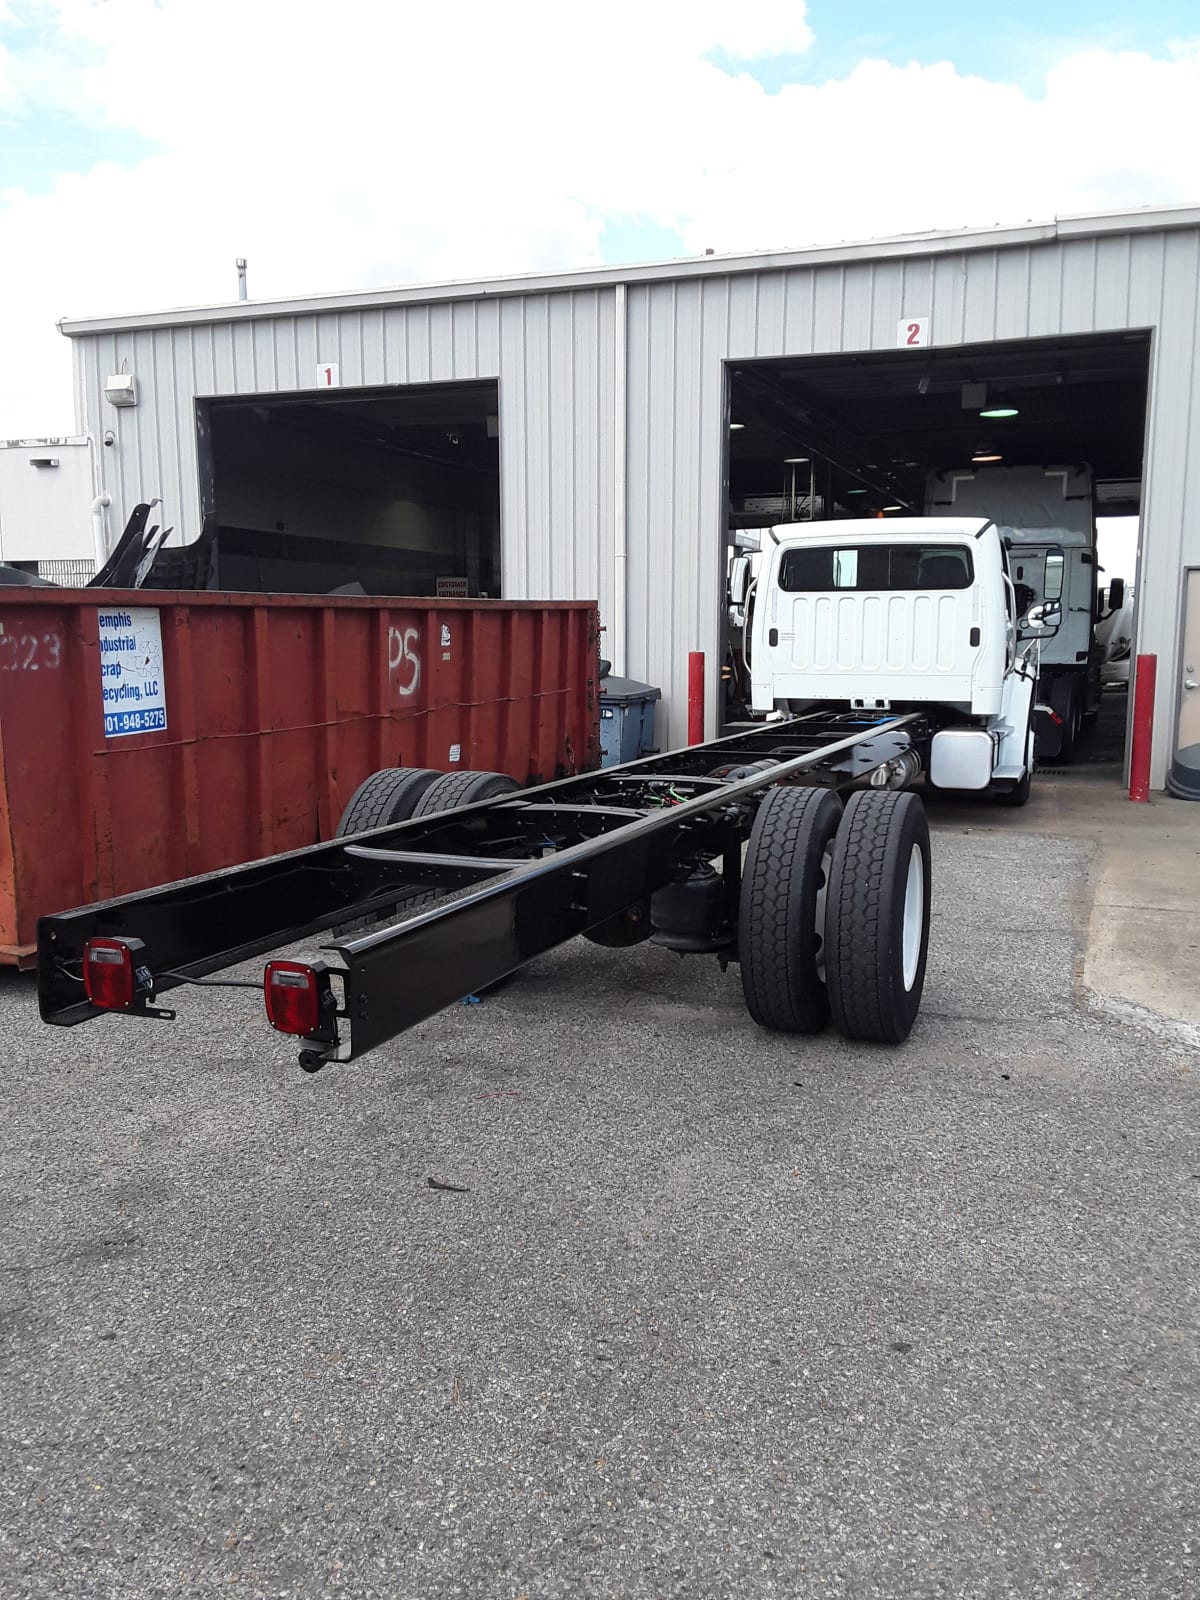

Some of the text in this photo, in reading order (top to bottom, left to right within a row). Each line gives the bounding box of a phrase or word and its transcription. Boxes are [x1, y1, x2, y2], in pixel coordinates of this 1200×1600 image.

[907, 323, 920, 345] 2
[324, 367, 331, 386] 1
[144, 680, 158, 697] LLC
[105, 710, 164, 732] 01-948-5275
